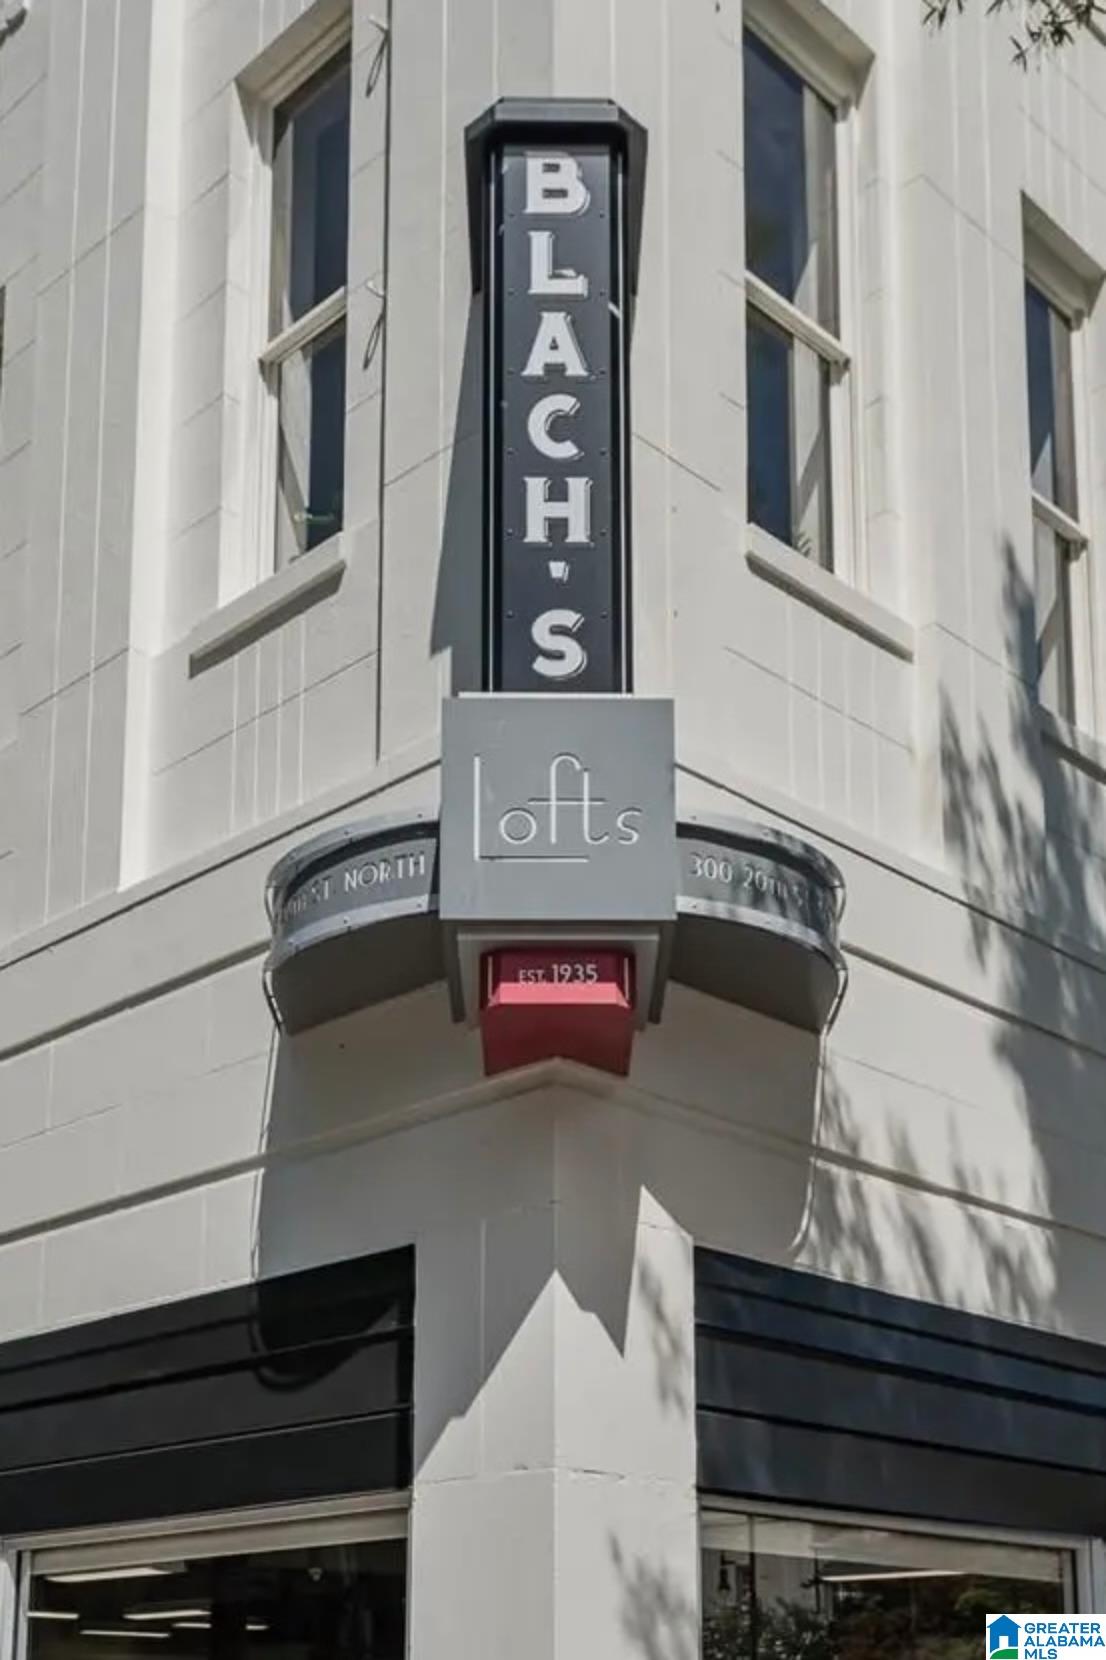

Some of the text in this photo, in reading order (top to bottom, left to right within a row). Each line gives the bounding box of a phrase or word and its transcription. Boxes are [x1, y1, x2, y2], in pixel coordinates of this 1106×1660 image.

[522, 151, 594, 680] BLACH'S
[473, 752, 643, 862] Lofts
[344, 852, 425, 893] NORTH
[689, 853, 733, 883] 300
[551, 963, 599, 984] 1935
